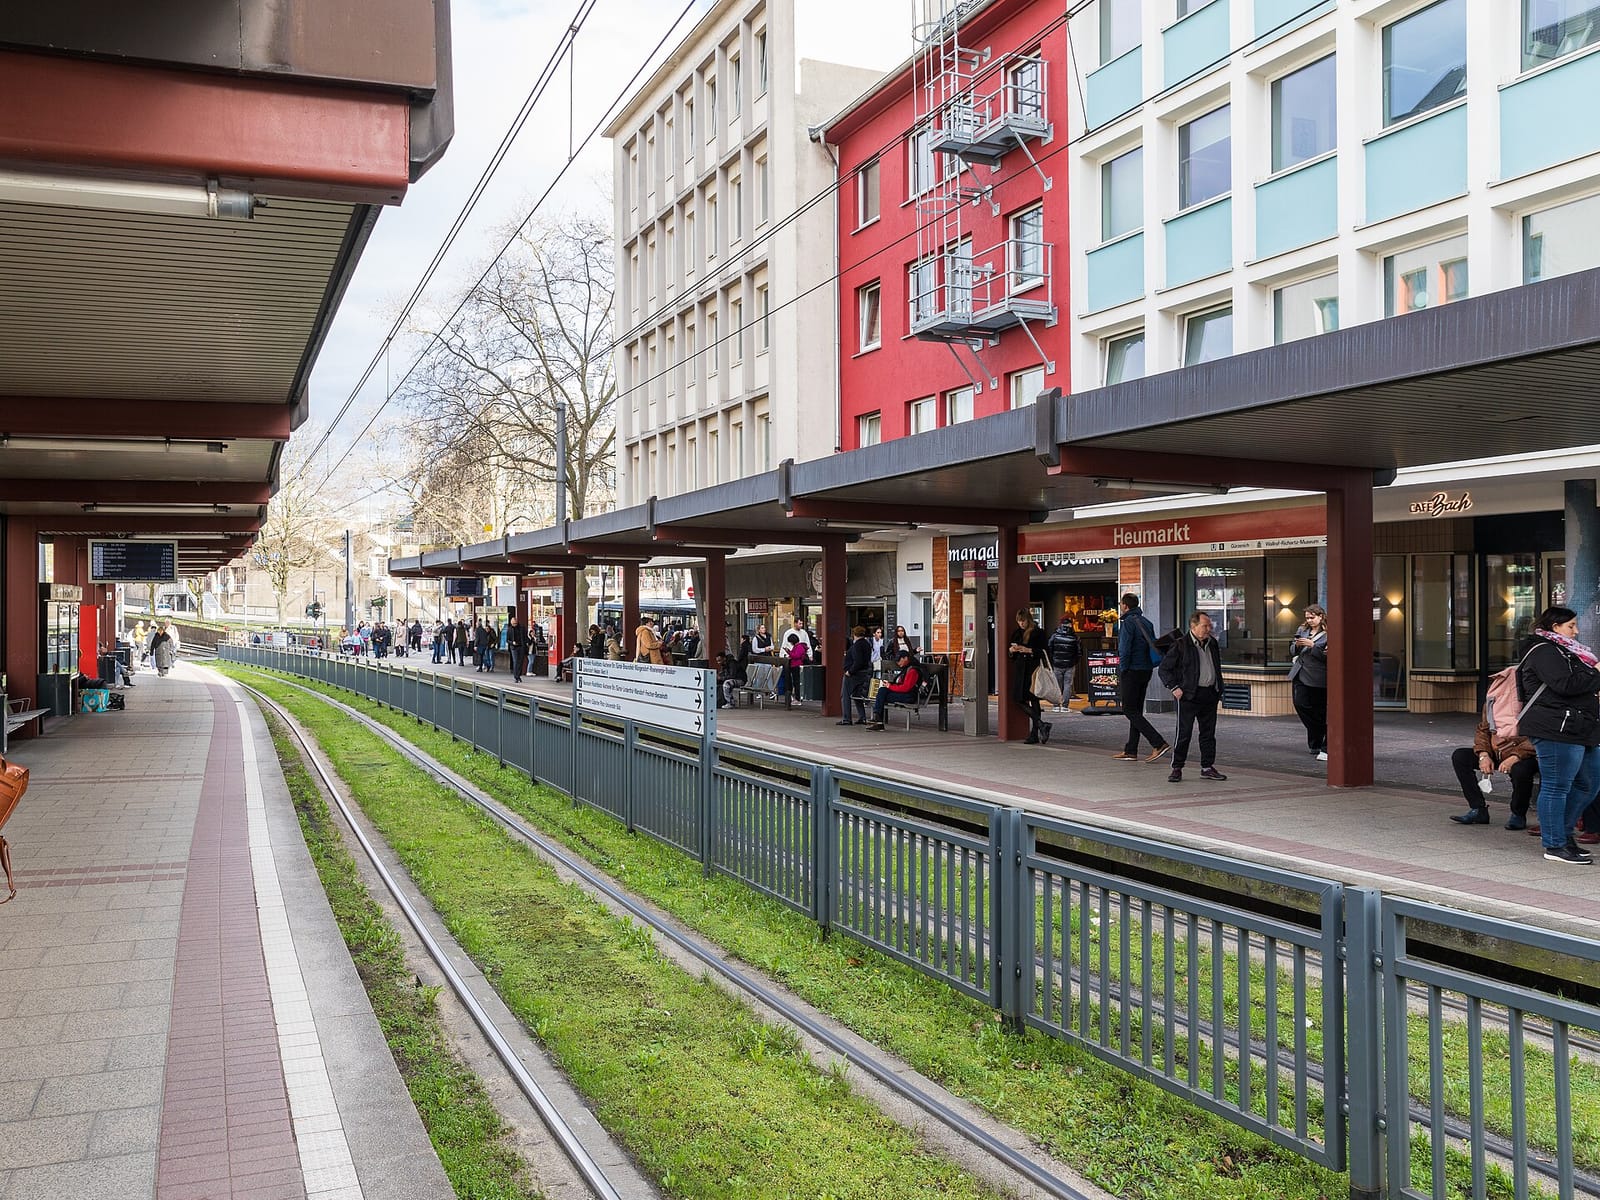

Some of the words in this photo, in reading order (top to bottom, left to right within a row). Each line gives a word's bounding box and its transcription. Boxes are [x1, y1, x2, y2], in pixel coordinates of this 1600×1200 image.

[1431, 492, 1472, 517] Bach
[1113, 522, 1190, 546] Heumarkt
[948, 540, 999, 561] mangal
[748, 602, 768, 610] KIOSK
[1092, 666, 1117, 674] GEÖFFNET
